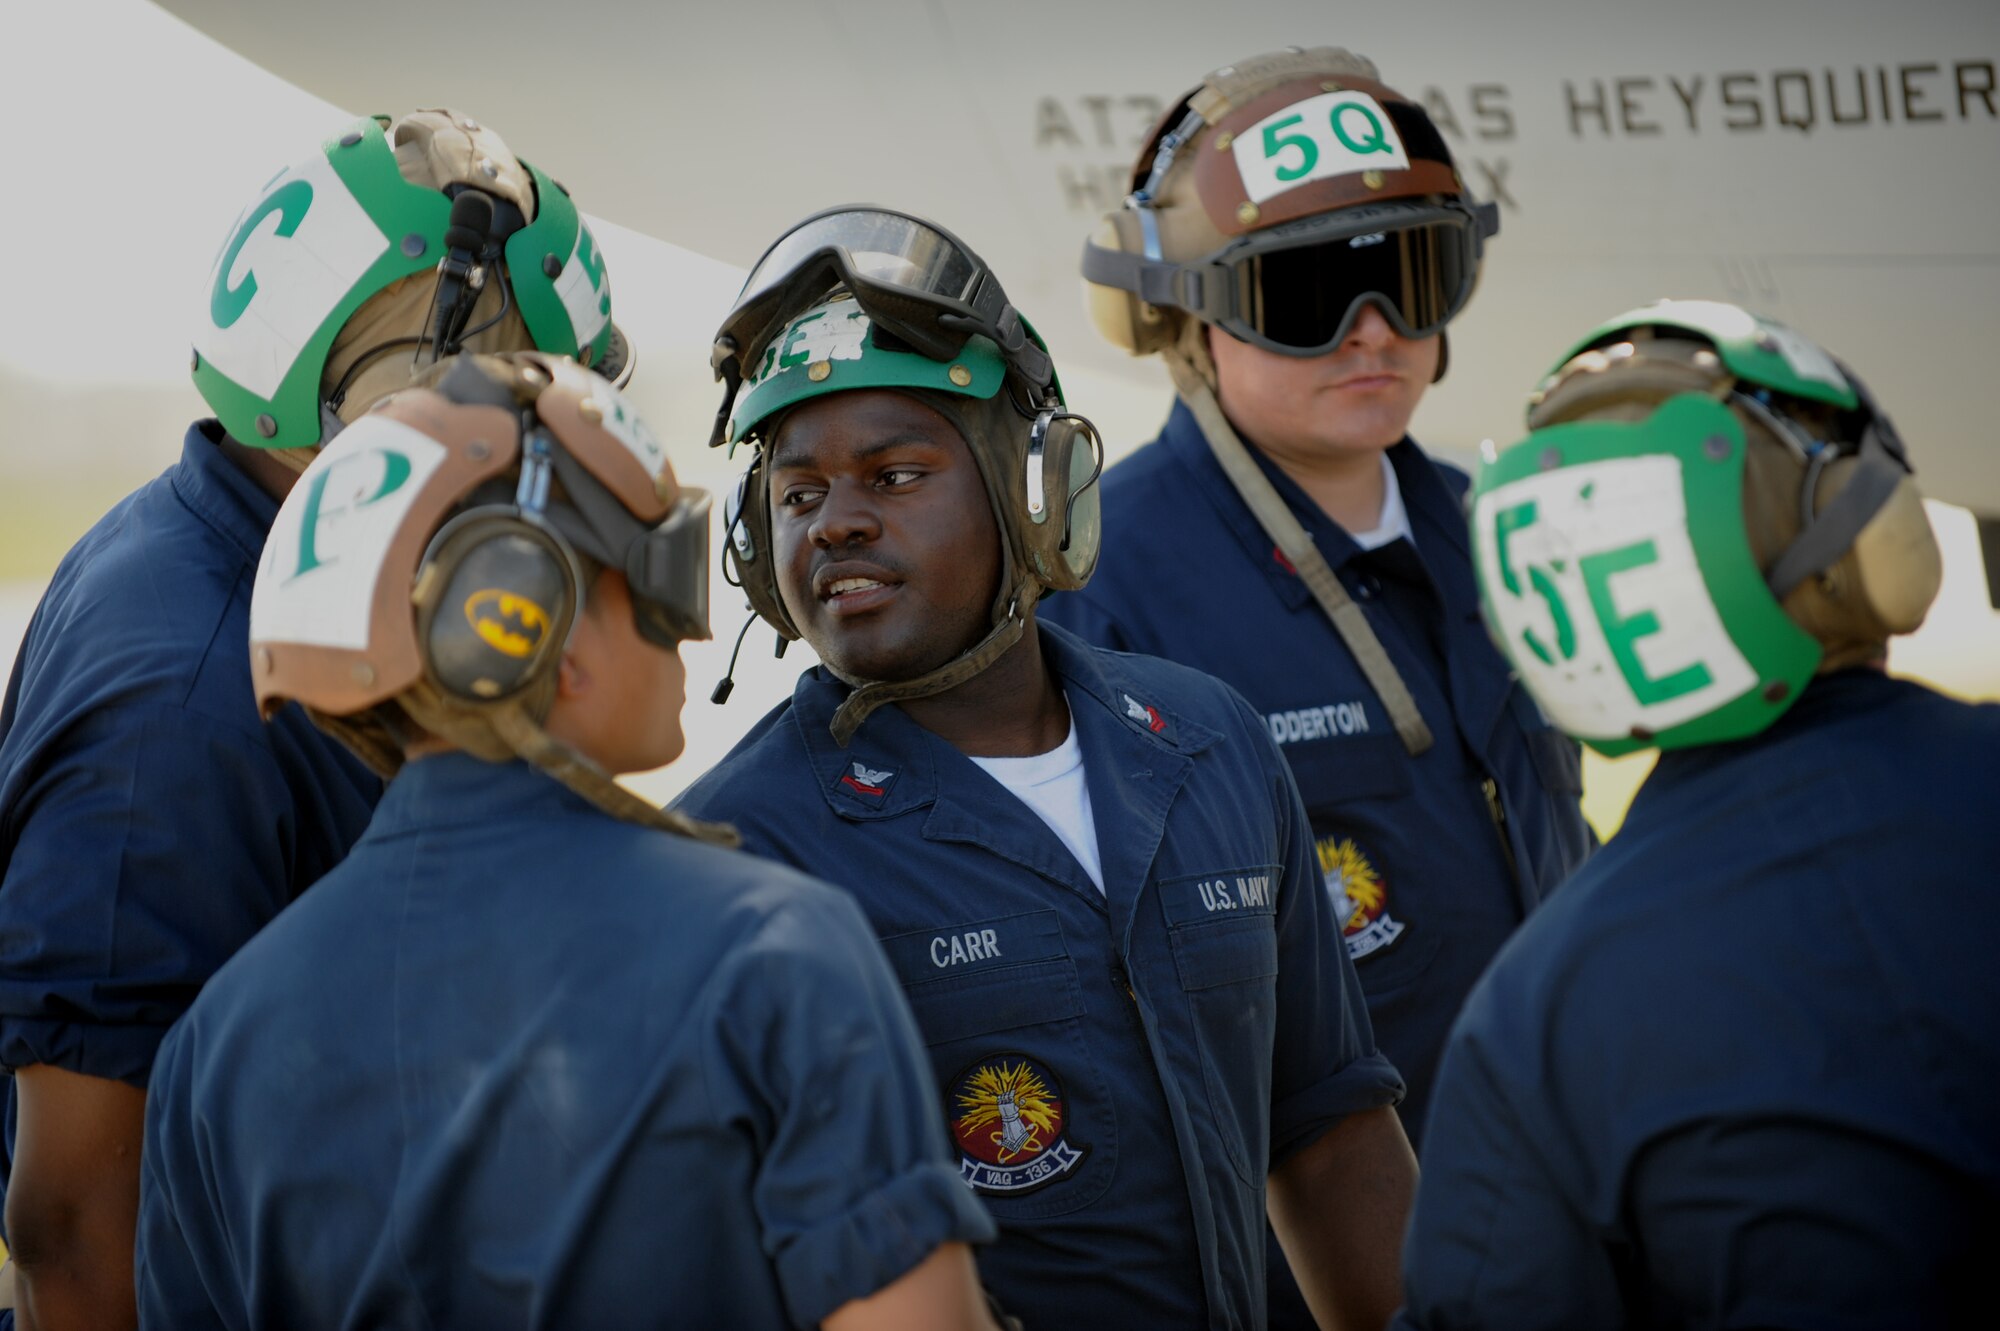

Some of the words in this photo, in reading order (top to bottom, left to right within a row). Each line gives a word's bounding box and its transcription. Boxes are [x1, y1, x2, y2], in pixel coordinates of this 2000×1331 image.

[1428, 82, 1517, 142] AS
[1564, 58, 1999, 141] HEYSQUIER
[1266, 701, 1370, 744] DDERTON
[1198, 879, 1237, 912] U.S.
[1236, 875, 1269, 908] NAVY
[930, 928, 1002, 969] CARR
[986, 1170, 1012, 1186] VAQ
[1025, 1160, 1052, 1181] 136
